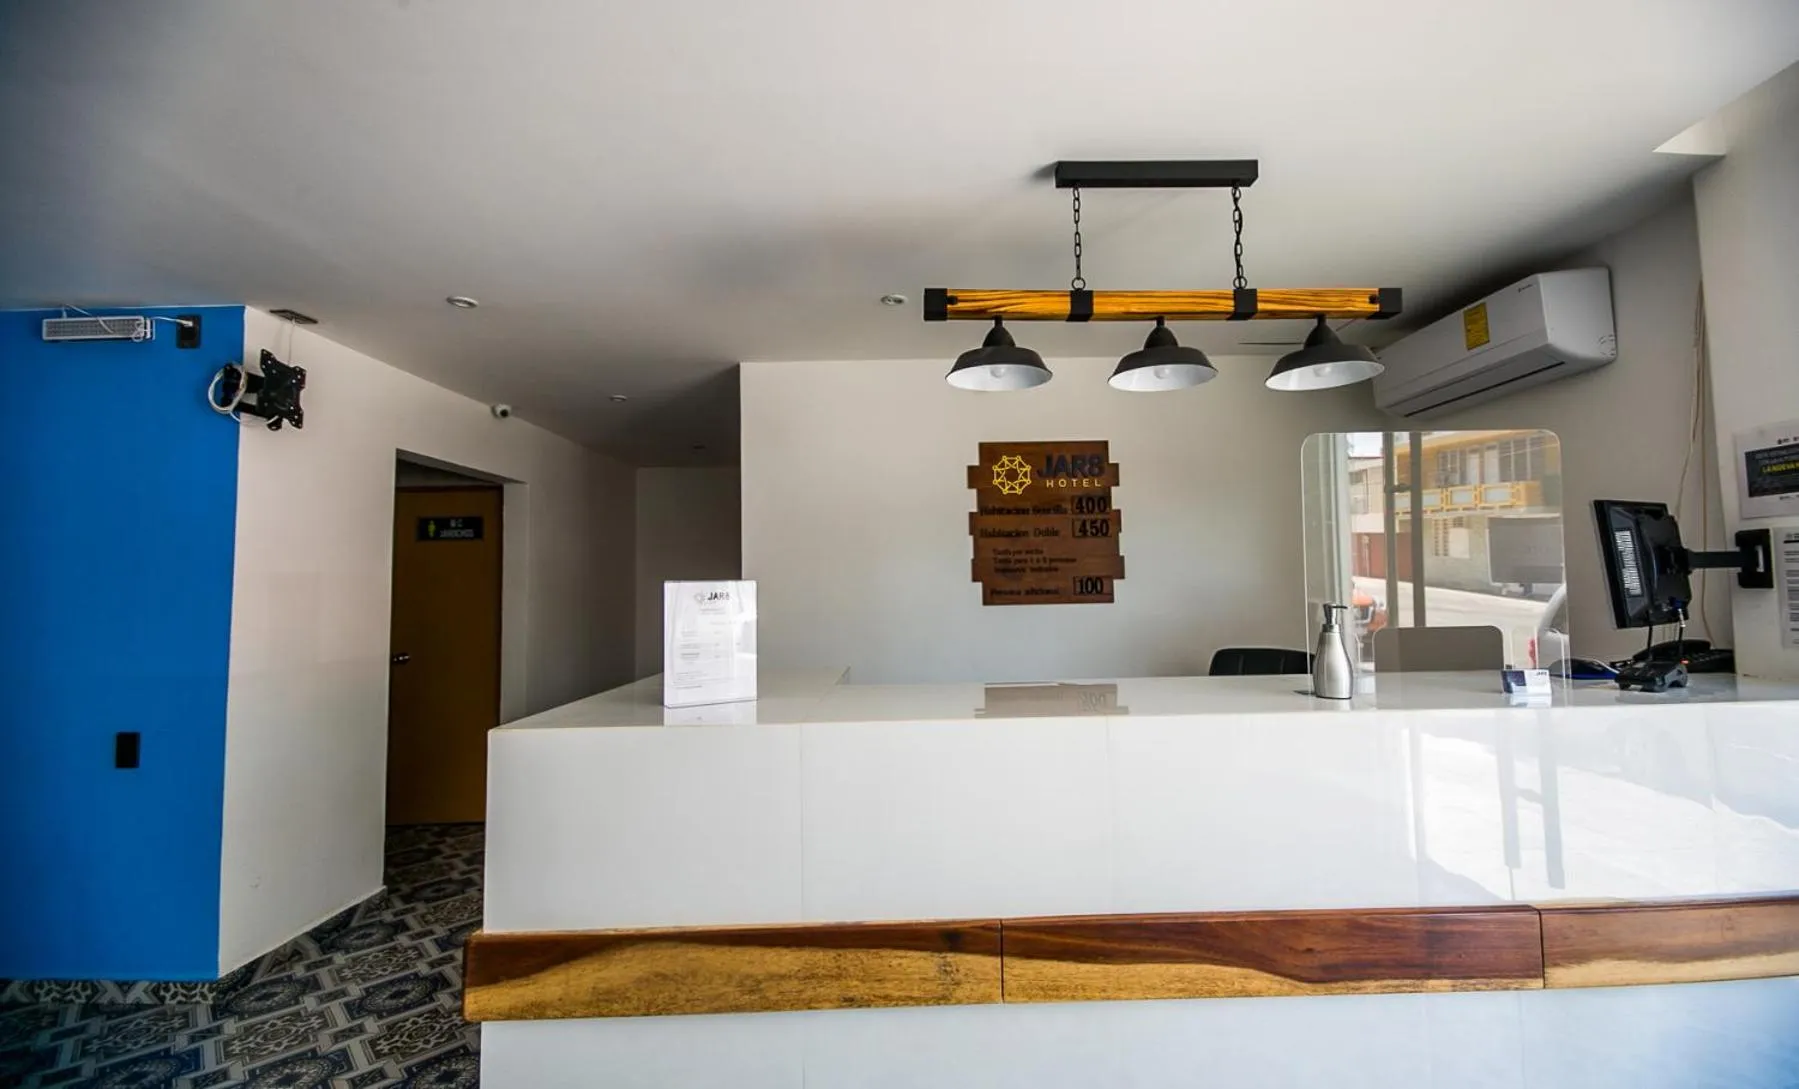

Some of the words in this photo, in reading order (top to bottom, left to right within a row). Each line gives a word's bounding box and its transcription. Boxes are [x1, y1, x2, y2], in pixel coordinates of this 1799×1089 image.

[1046, 478, 1102, 488] HOTEL
[1075, 496, 1107, 514] 400
[1034, 526, 1060, 537] Doble
[1078, 519, 1110, 537] 450
[1079, 576, 1104, 595] 100
